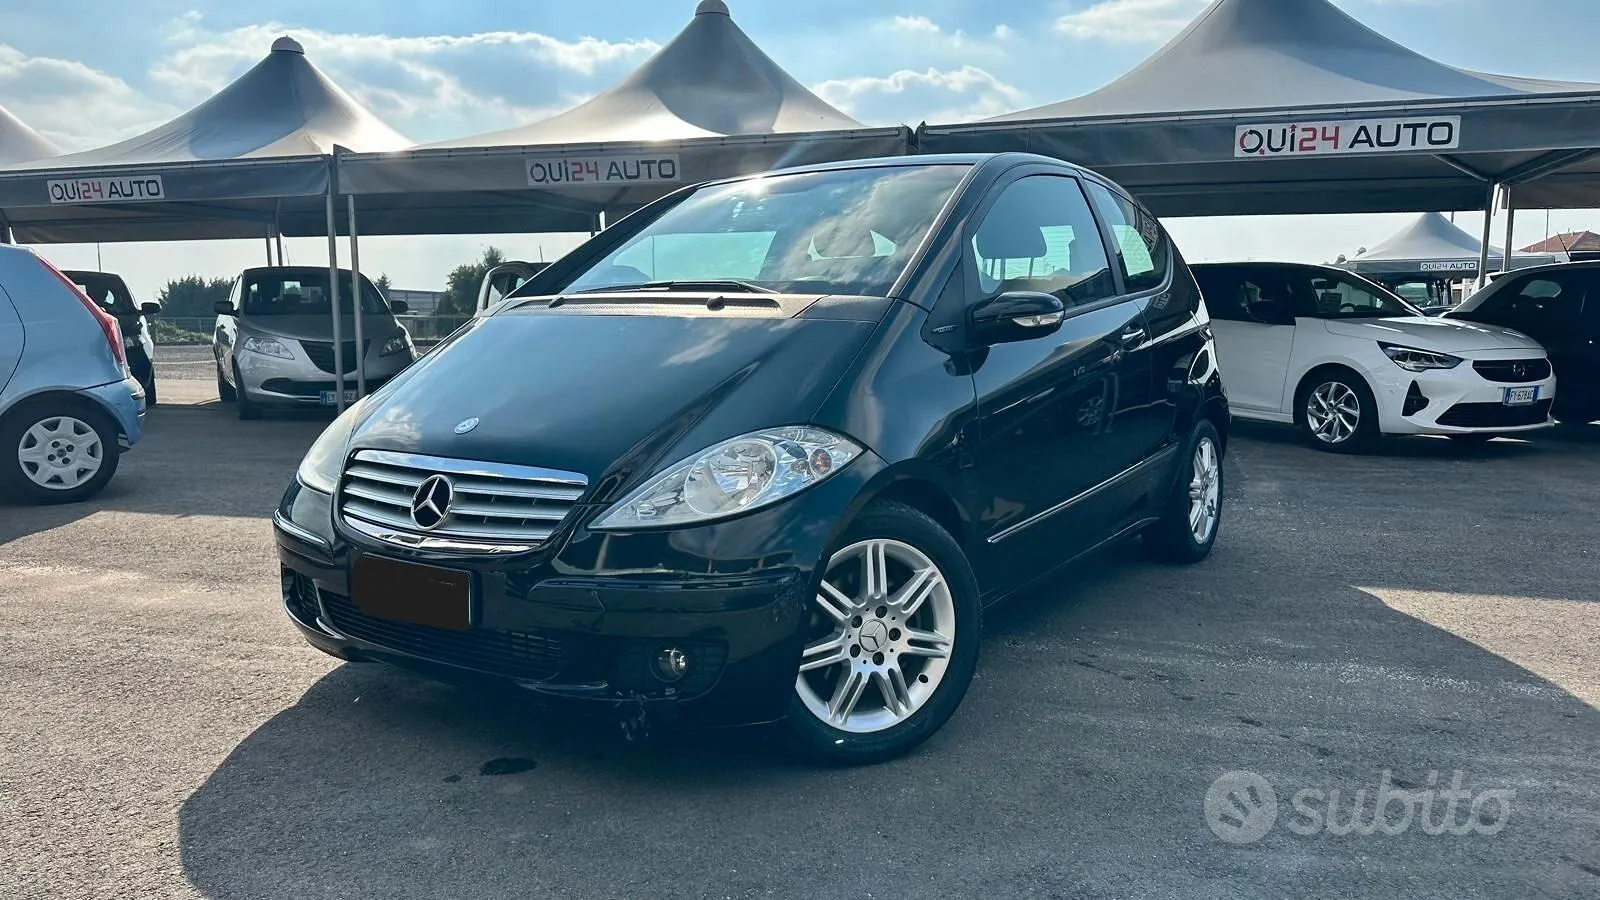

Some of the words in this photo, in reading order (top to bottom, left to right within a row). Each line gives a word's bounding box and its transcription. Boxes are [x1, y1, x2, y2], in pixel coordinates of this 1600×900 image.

[1349, 121, 1453, 148] AUTO
[606, 159, 676, 181] AUTO
[109, 180, 160, 198] AUTO
